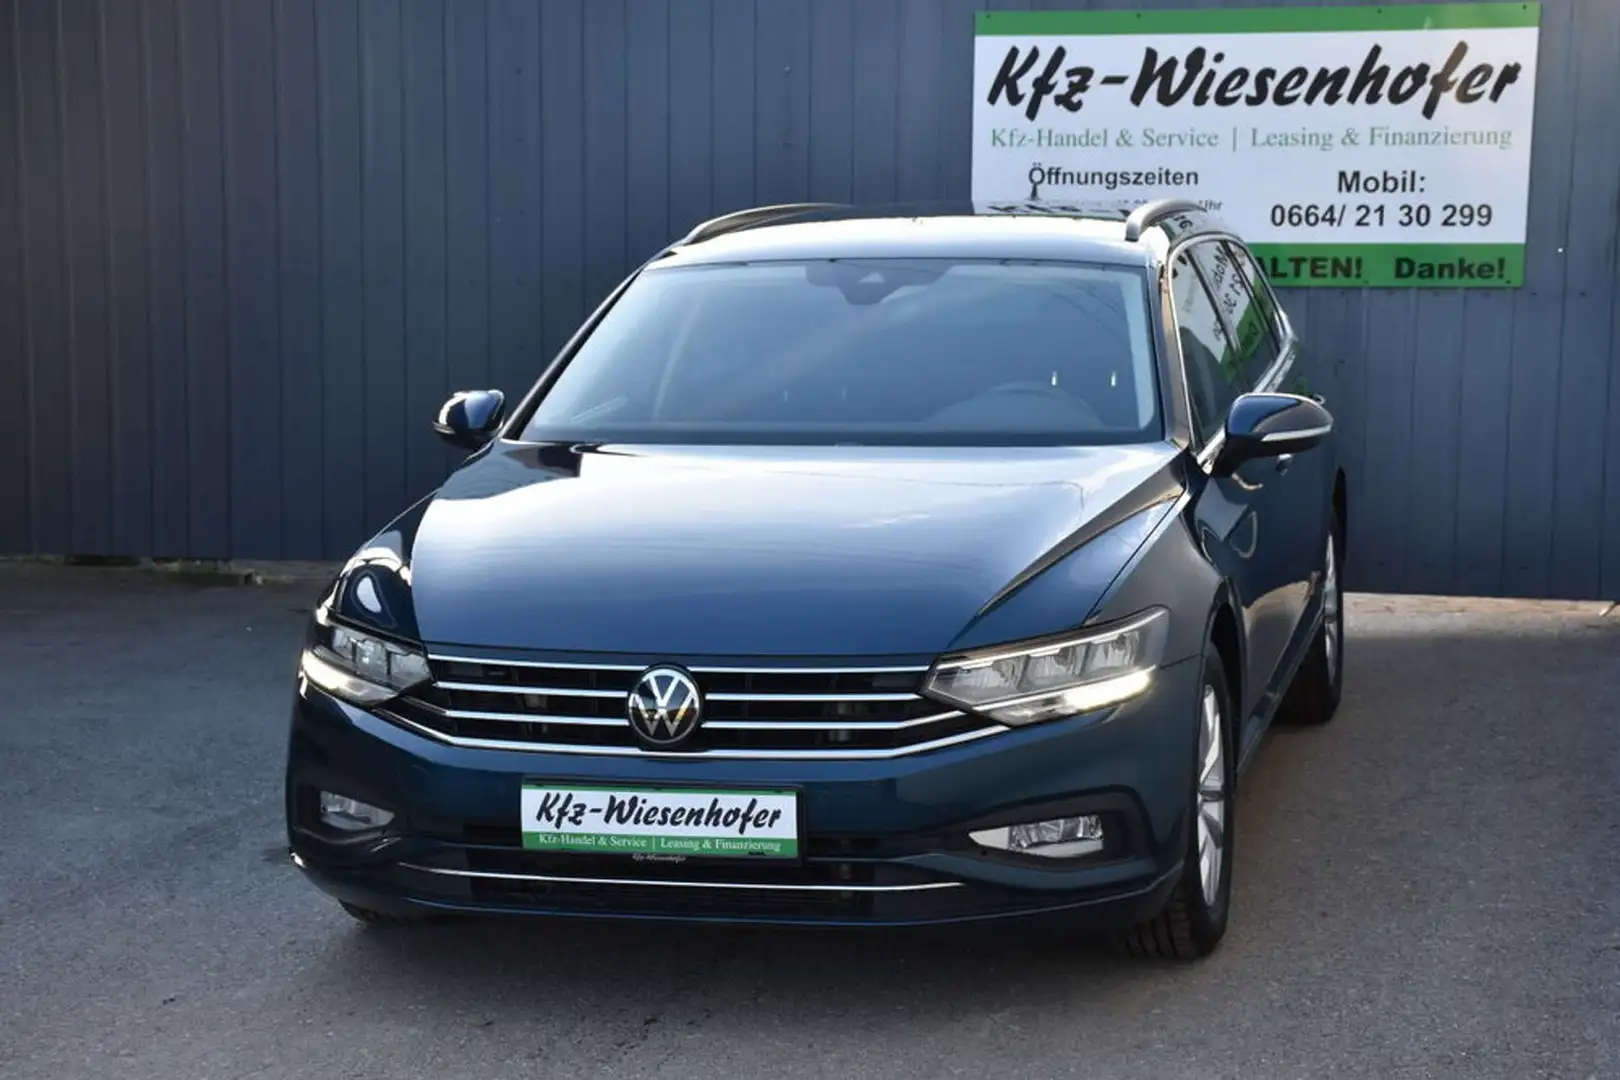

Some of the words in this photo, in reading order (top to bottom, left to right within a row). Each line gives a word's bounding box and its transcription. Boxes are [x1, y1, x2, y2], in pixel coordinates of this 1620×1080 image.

[987, 40, 1522, 122] Kfz-Wiesenhofer
[990, 127, 1108, 149] Kfz-Handel
[1115, 130, 1133, 148] &
[1142, 127, 1219, 149] Service
[1251, 126, 1334, 152] Leasing
[1341, 127, 1360, 147] &
[1368, 124, 1513, 150] Finanzierung
[1029, 162, 1199, 190] Öffnungszeiten
[1337, 169, 1426, 194] Mobil:
[1271, 203, 1346, 227] 0664/
[1354, 203, 1386, 227] 21
[1398, 203, 1431, 227] 30
[1441, 203, 1493, 228] 299
[1394, 256, 1506, 281] Danke!
[536, 792, 781, 835] Kfz-Wiesenhofer
[539, 833, 597, 847] Kfz-Handel
[599, 835, 608, 847] &
[610, 836, 647, 848] Service
[660, 838, 700, 852] Leasing
[702, 839, 713, 850] &
[715, 838, 782, 853] Finanzierung
